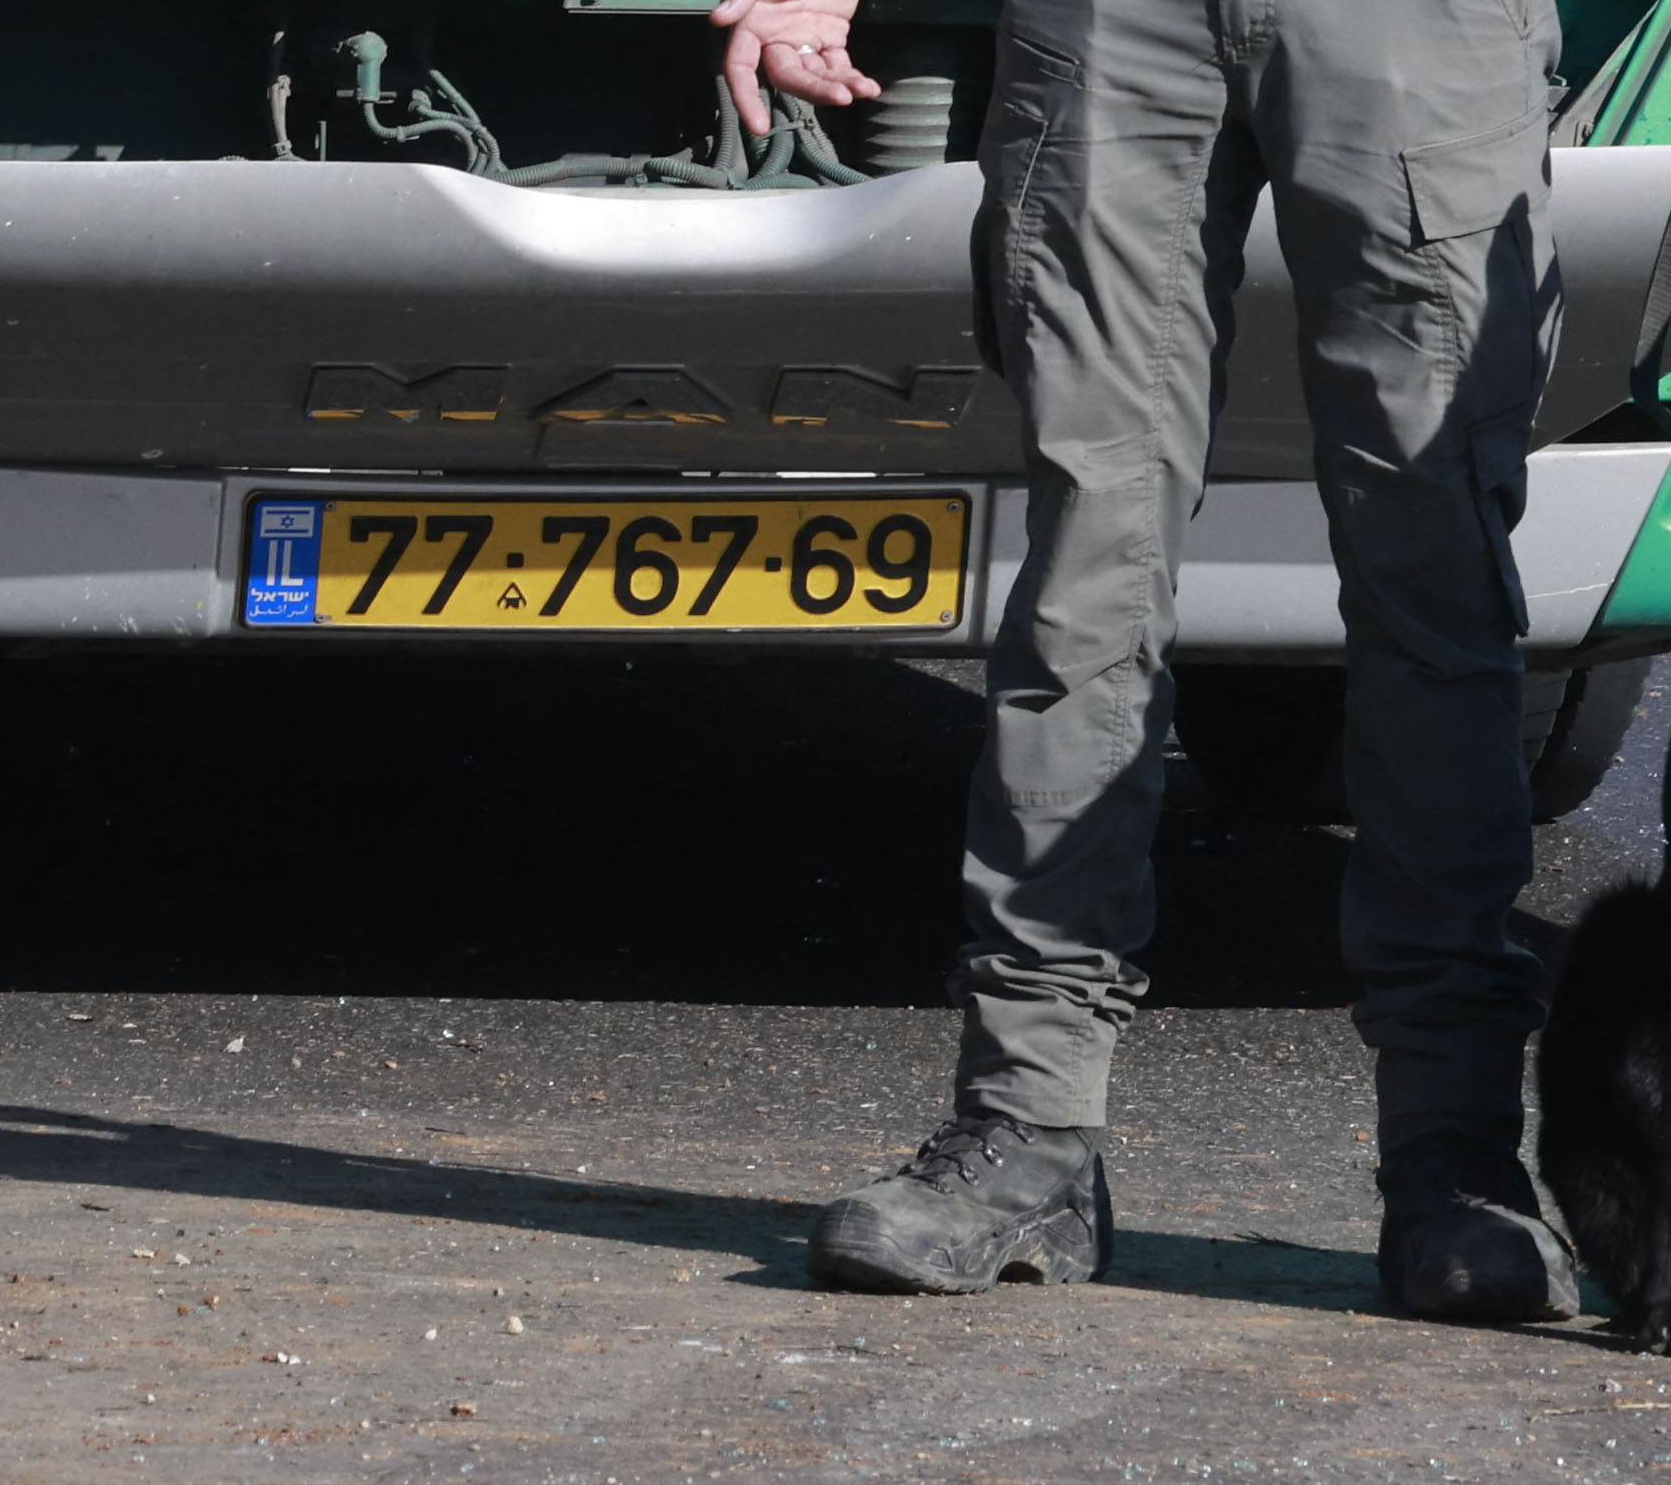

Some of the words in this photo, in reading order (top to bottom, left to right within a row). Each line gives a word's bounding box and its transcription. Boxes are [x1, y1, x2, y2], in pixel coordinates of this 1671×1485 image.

[305, 362, 984, 428] MAN
[265, 539, 305, 587] IL
[250, 587, 310, 603] ישראל
